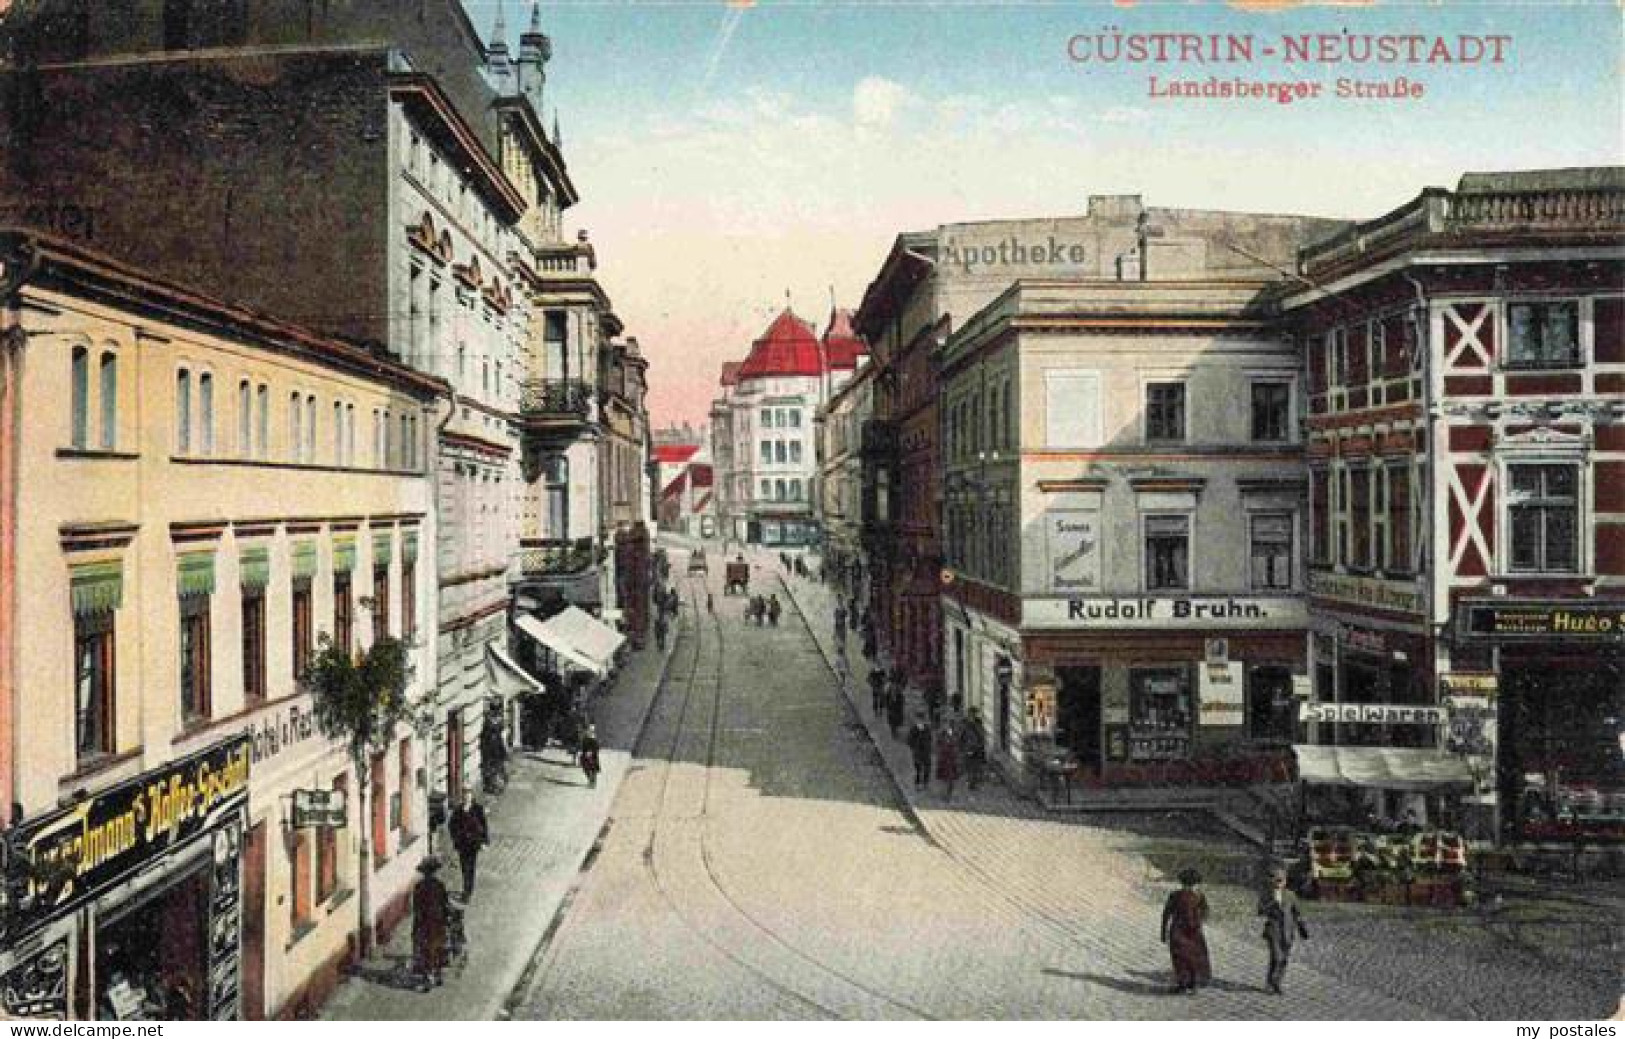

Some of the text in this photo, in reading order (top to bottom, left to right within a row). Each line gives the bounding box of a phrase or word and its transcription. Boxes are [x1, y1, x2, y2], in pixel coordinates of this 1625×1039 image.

[942, 236, 1085, 273] Apotheke
[1067, 600, 1269, 620] Rudolf Bruhn.
